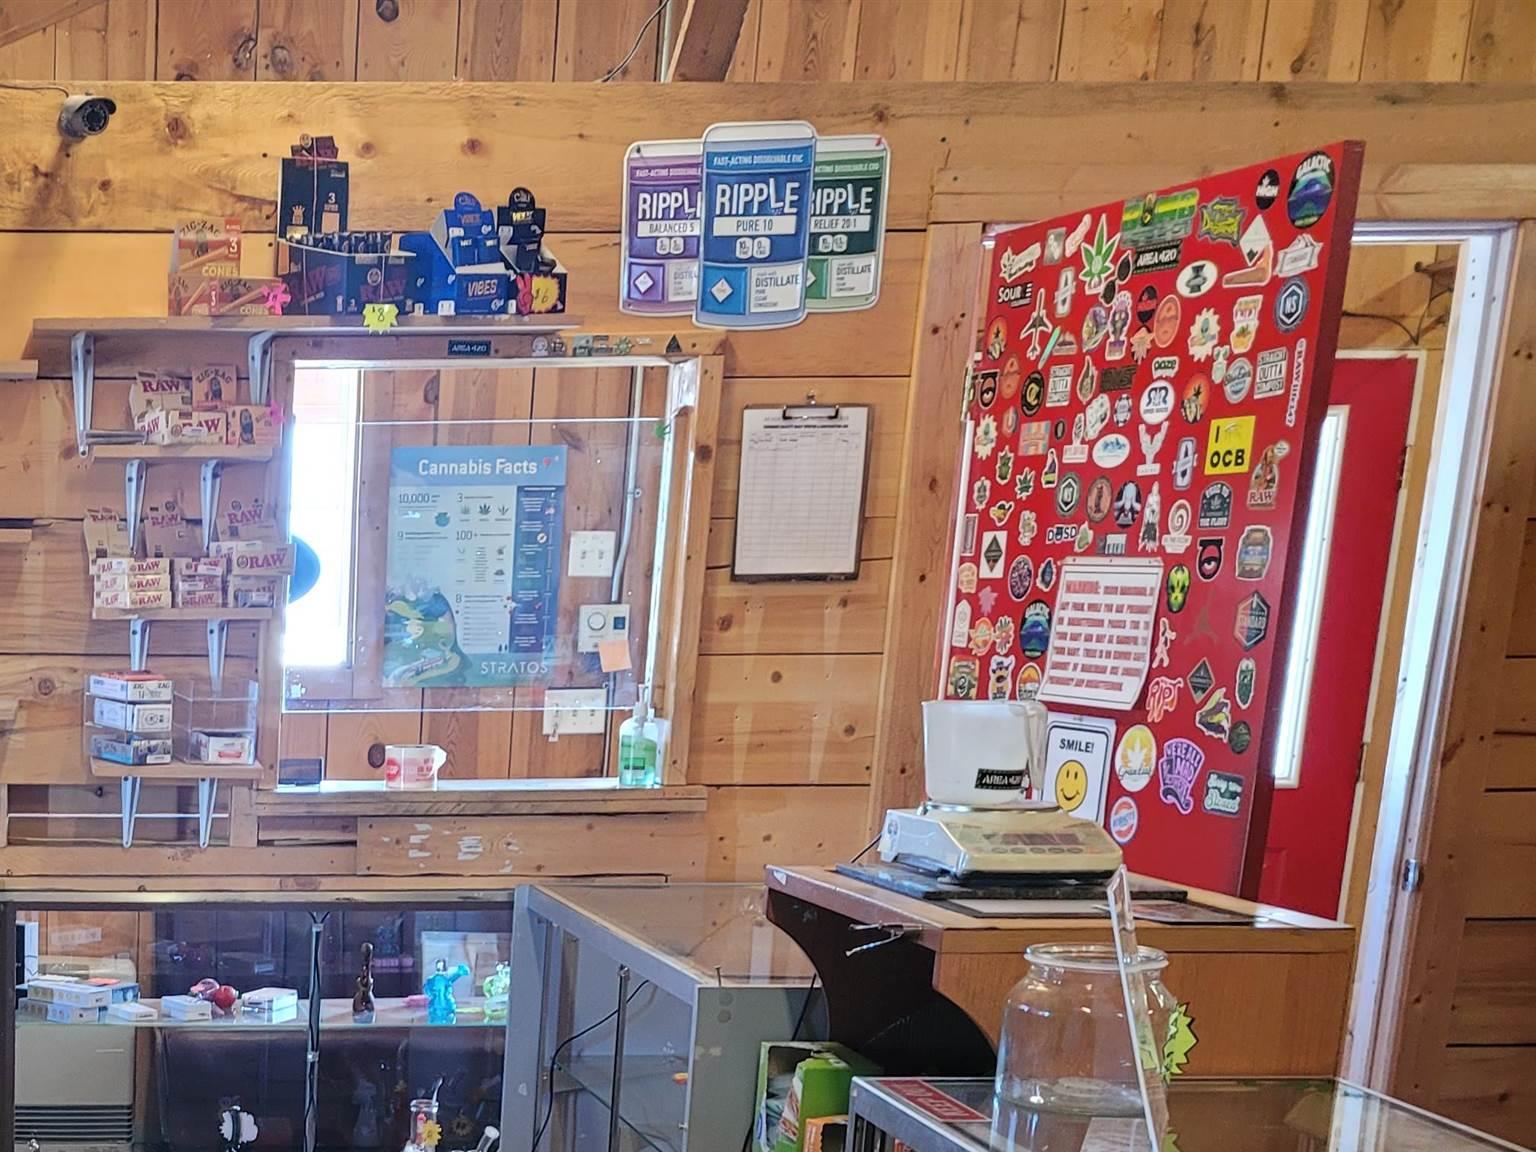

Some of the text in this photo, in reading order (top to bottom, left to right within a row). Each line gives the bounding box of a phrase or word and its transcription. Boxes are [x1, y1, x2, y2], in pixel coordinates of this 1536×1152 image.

[1295, 154, 1332, 179] GALACTIC
[328, 192, 336, 204] 3
[716, 178, 800, 215] RIPPLE
[649, 223, 687, 233] BALANCED
[736, 219, 773, 232] PURE 10
[814, 219, 840, 229] RELIEF
[229, 236, 238, 252] 3
[1136, 249, 1177, 267] AREA 420
[836, 264, 872, 276] DISTILLATE
[755, 274, 800, 288] DISTILLATE
[468, 280, 498, 297] VIBES
[1259, 365, 1283, 380] OUTTA
[142, 380, 180, 393] RAW
[1214, 425, 1221, 443] I
[1209, 448, 1245, 469] OCB
[418, 458, 537, 475] Cannabis Facts
[398, 493, 431, 504] 10,000
[457, 493, 464, 503] 3
[1249, 490, 1274, 503] RAW
[227, 509, 263, 524] RAW
[137, 561, 161, 571] RAW
[248, 552, 286, 569] RAW
[137, 578, 161, 588] RAW
[139, 595, 163, 605] RAW
[480, 661, 548, 675] STRATOS
[1059, 738, 1094, 754] SMILE!
